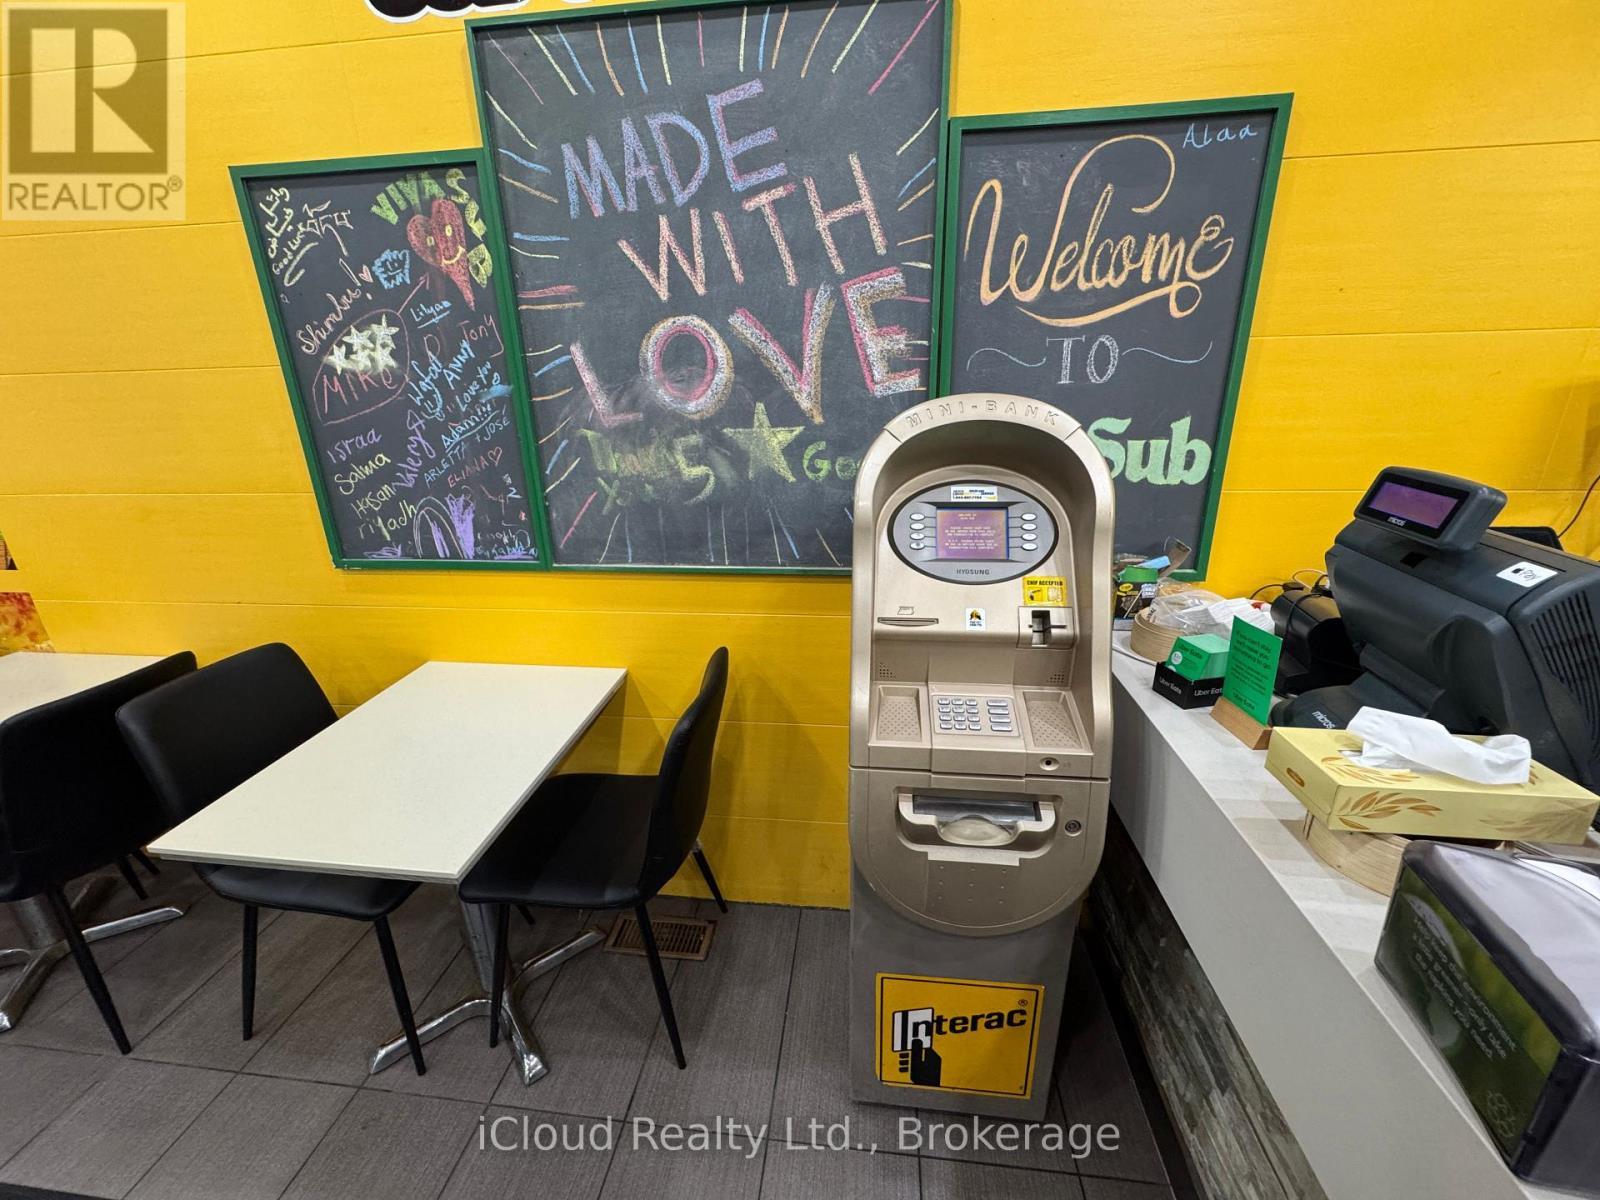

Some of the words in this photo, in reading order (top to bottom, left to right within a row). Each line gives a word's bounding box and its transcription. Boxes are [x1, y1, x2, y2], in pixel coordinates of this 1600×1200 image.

[561, 79, 788, 219] MADE
[617, 152, 887, 301] WITH
[964, 133, 1234, 328] Welcome
[569, 266, 922, 427] LOVE
[1046, 335, 1119, 384] TO
[956, 568, 990, 576] HYOSUNG
[1194, 689, 1210, 697] Uber
